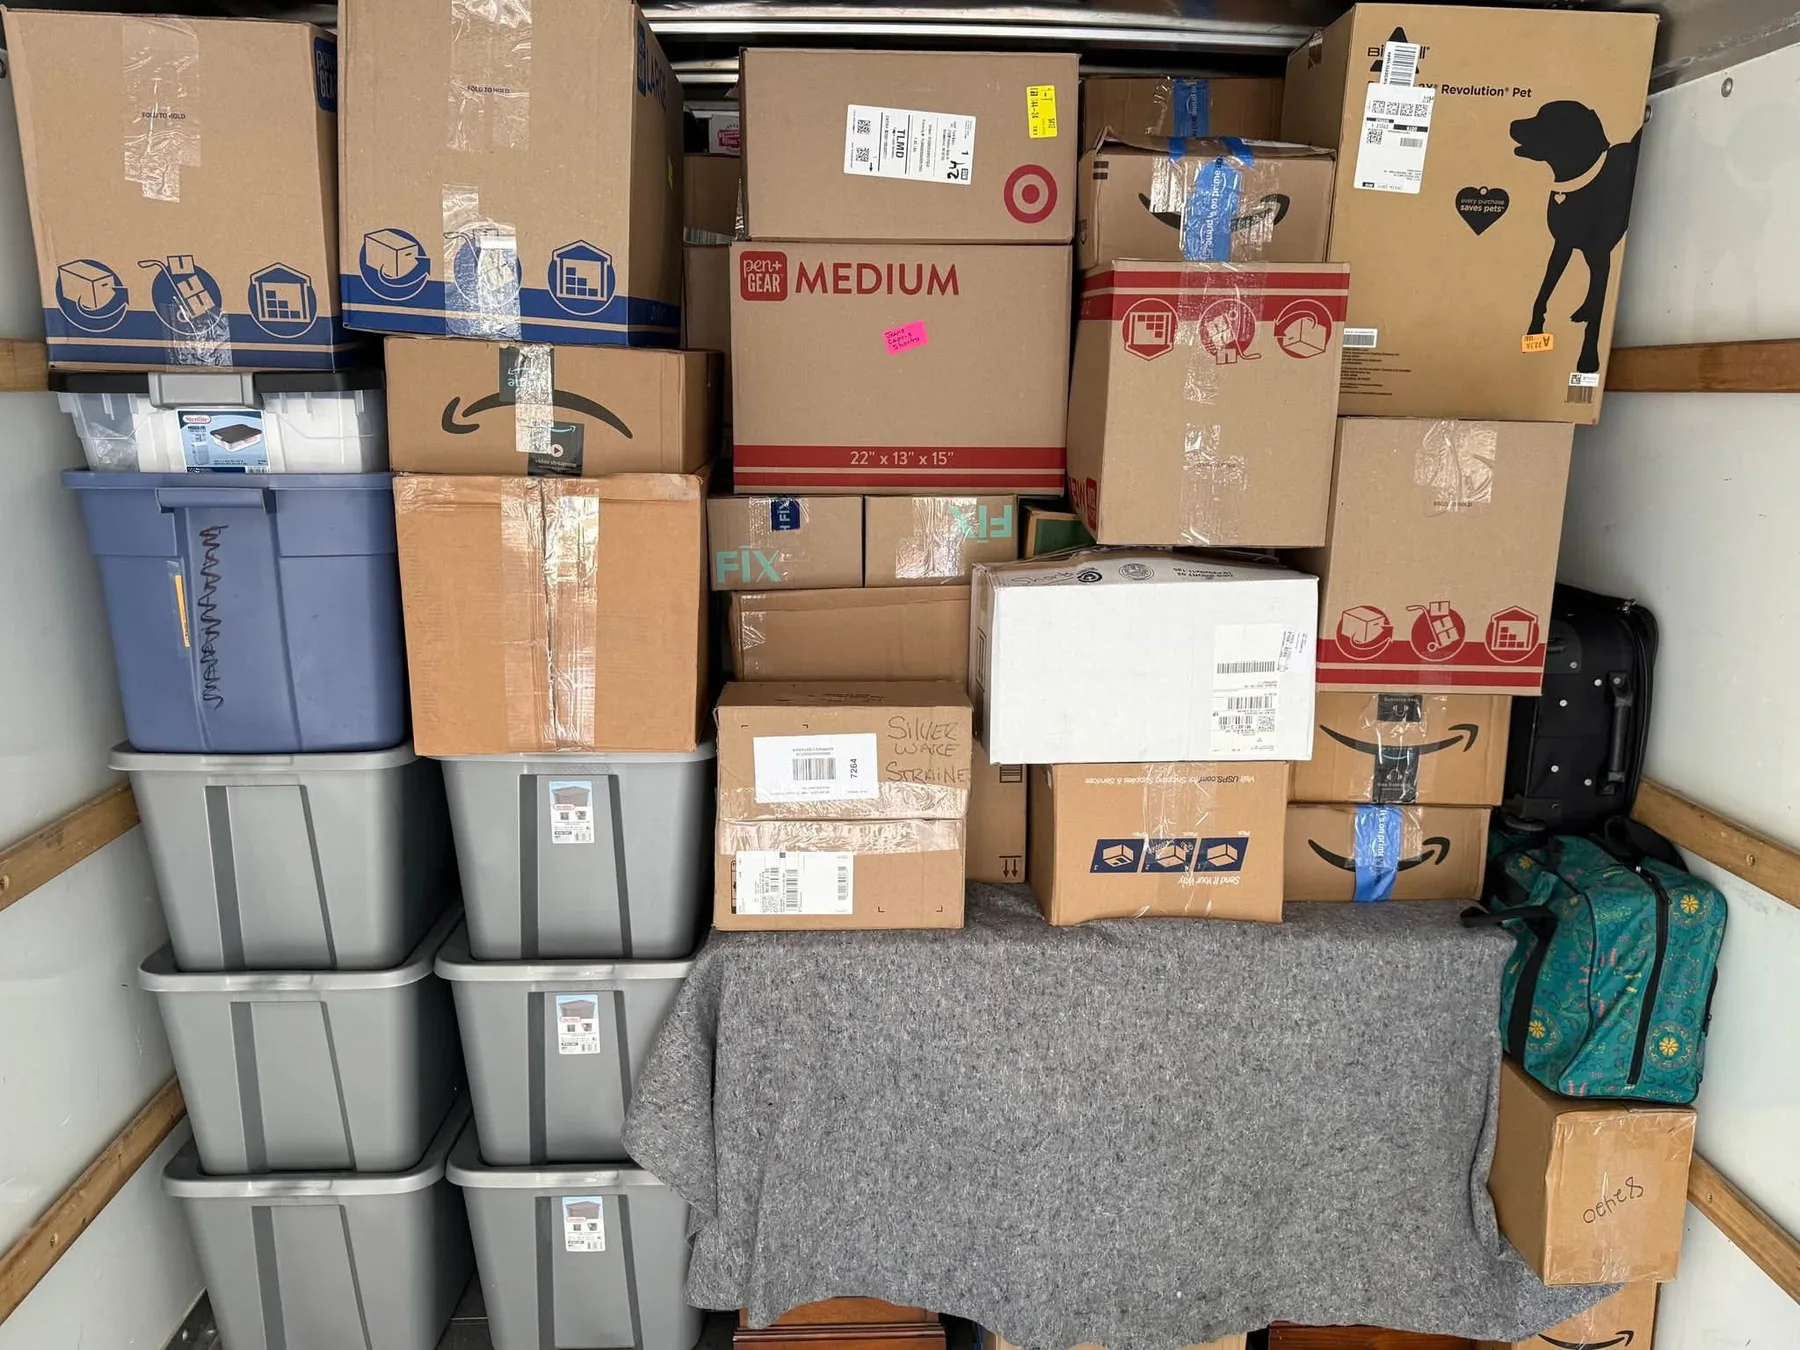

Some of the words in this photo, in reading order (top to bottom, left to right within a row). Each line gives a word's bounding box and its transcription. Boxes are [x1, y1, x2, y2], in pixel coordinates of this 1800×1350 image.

[1367, 44, 1426, 60] Bill
[1441, 84, 1504, 97] Revolution
[1512, 87, 1532, 98] Pet
[895, 129, 907, 159] TLMD
[1212, 170, 1222, 197] prime
[1460, 204, 1482, 212] saves
[747, 273, 781, 293] GEAR
[795, 261, 960, 296] MEDIUM
[1542, 336, 1551, 347] A
[850, 450, 876, 466] 22"
[880, 455, 888, 465] x
[892, 450, 914, 466] 13"
[919, 455, 927, 465] x
[931, 451, 954, 466] 15"
[849, 758, 858, 779] 7264
[1084, 776, 1116, 785] Services
[1378, 823, 1386, 834] on
[1220, 875, 1241, 886] Send
